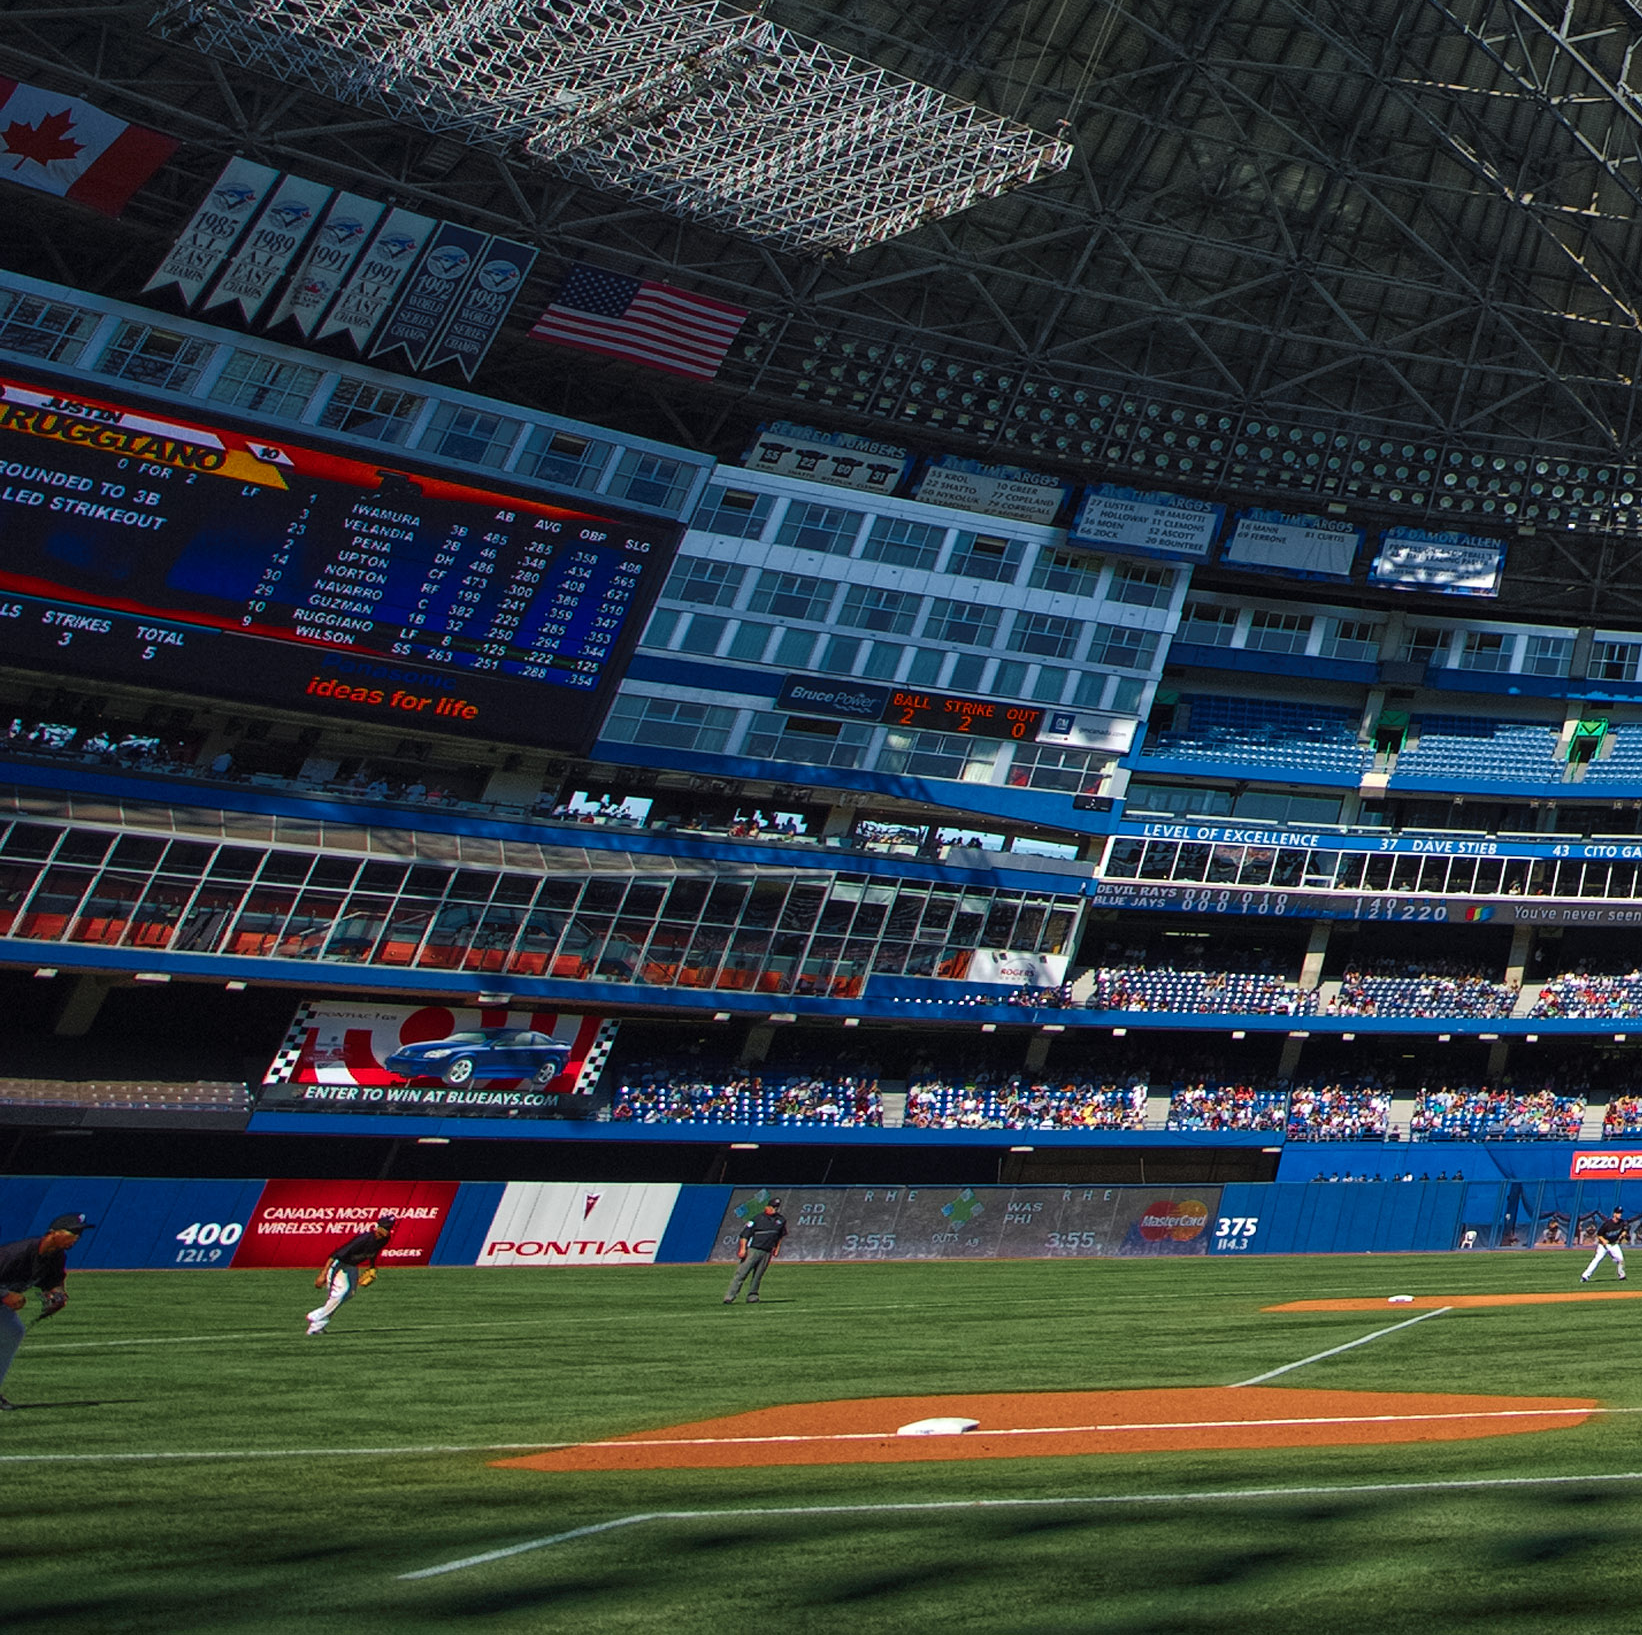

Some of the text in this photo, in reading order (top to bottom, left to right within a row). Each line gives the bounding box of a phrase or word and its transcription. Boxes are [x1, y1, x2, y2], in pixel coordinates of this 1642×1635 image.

[193, 211, 241, 240] 1985
[252, 228, 296, 257] 1989
[170, 245, 218, 273] EAST
[309, 244, 351, 274] 1991
[231, 263, 277, 288] EAST
[361, 260, 402, 287] 1991
[415, 273, 455, 301] 1992
[341, 295, 384, 318] EAST
[467, 287, 507, 314] 1993
[41, 396, 124, 424] JUSTIN
[1, 404, 228, 471] RUGGIANO
[769, 421, 908, 459] RETIRED NUMBERS
[117, 458, 262, 498] 0 FOR 2 LF
[100, 481, 162, 508] TO 3B
[50, 495, 168, 532] STRIKEOUT
[351, 502, 422, 528] IWAMURA
[343, 517, 415, 543] VELANDIA
[494, 509, 653, 554] AB AVG SLG
[1460, 533, 1501, 549] ALLEN
[351, 535, 393, 554] PENA
[337, 549, 391, 570] UPTON
[323, 563, 389, 586] NORTON
[313, 578, 384, 602] NAVARRO
[307, 593, 375, 616] GUZMAN
[41, 609, 186, 647] STRIKES TOTAL
[247, 599, 267, 614] 10
[292, 607, 374, 633] RUGGIANO
[400, 627, 420, 641] LF
[56, 631, 158, 661] 3 5
[294, 624, 357, 646] WILSON
[305, 675, 480, 721] ideas for life
[790, 685, 878, 710] Bruce Power
[893, 691, 1040, 725] BALL STRIKE OUT
[899, 707, 1027, 739] 2 2 0
[1142, 823, 1193, 840] LEVEL
[1197, 827, 1219, 841] OF
[1223, 828, 1321, 849] EXCELLENCE
[1378, 838, 1399, 852] 37
[1411, 838, 1454, 854] DAVE
[1457, 842, 1498, 856] STIEB
[1551, 844, 1571, 857] 43
[1583, 845, 1618, 858] CITO
[1092, 894, 1167, 910] BLUE JAYS
[1096, 883, 1178, 900] DEVIL RAYS
[1513, 905, 1558, 922] You've
[1562, 909, 1608, 922] never
[1607, 910, 1642, 923] seen
[303, 1084, 560, 1108] ENTER TO WIN AT BLUEJAYS.COM
[1575, 1155, 1620, 1174] pizza
[263, 1206, 335, 1220] CANADA'S
[336, 1206, 378, 1220] MOST
[1002, 1213, 1033, 1225] PHI
[1006, 1202, 1044, 1213] WAS
[257, 1221, 324, 1235] WIRELESS
[796, 1215, 828, 1227] MIL
[1140, 1213, 1206, 1228] MasterCard
[1214, 1217, 1259, 1237] 375
[176, 1222, 244, 1246] 400
[842, 1234, 897, 1252] 3:55
[1044, 1232, 1096, 1250] 3:55
[1216, 1238, 1249, 1252] 114.3
[175, 1248, 223, 1263] 121.9
[381, 1248, 423, 1258] ROGERS
[486, 1239, 657, 1257] PONTIAC
